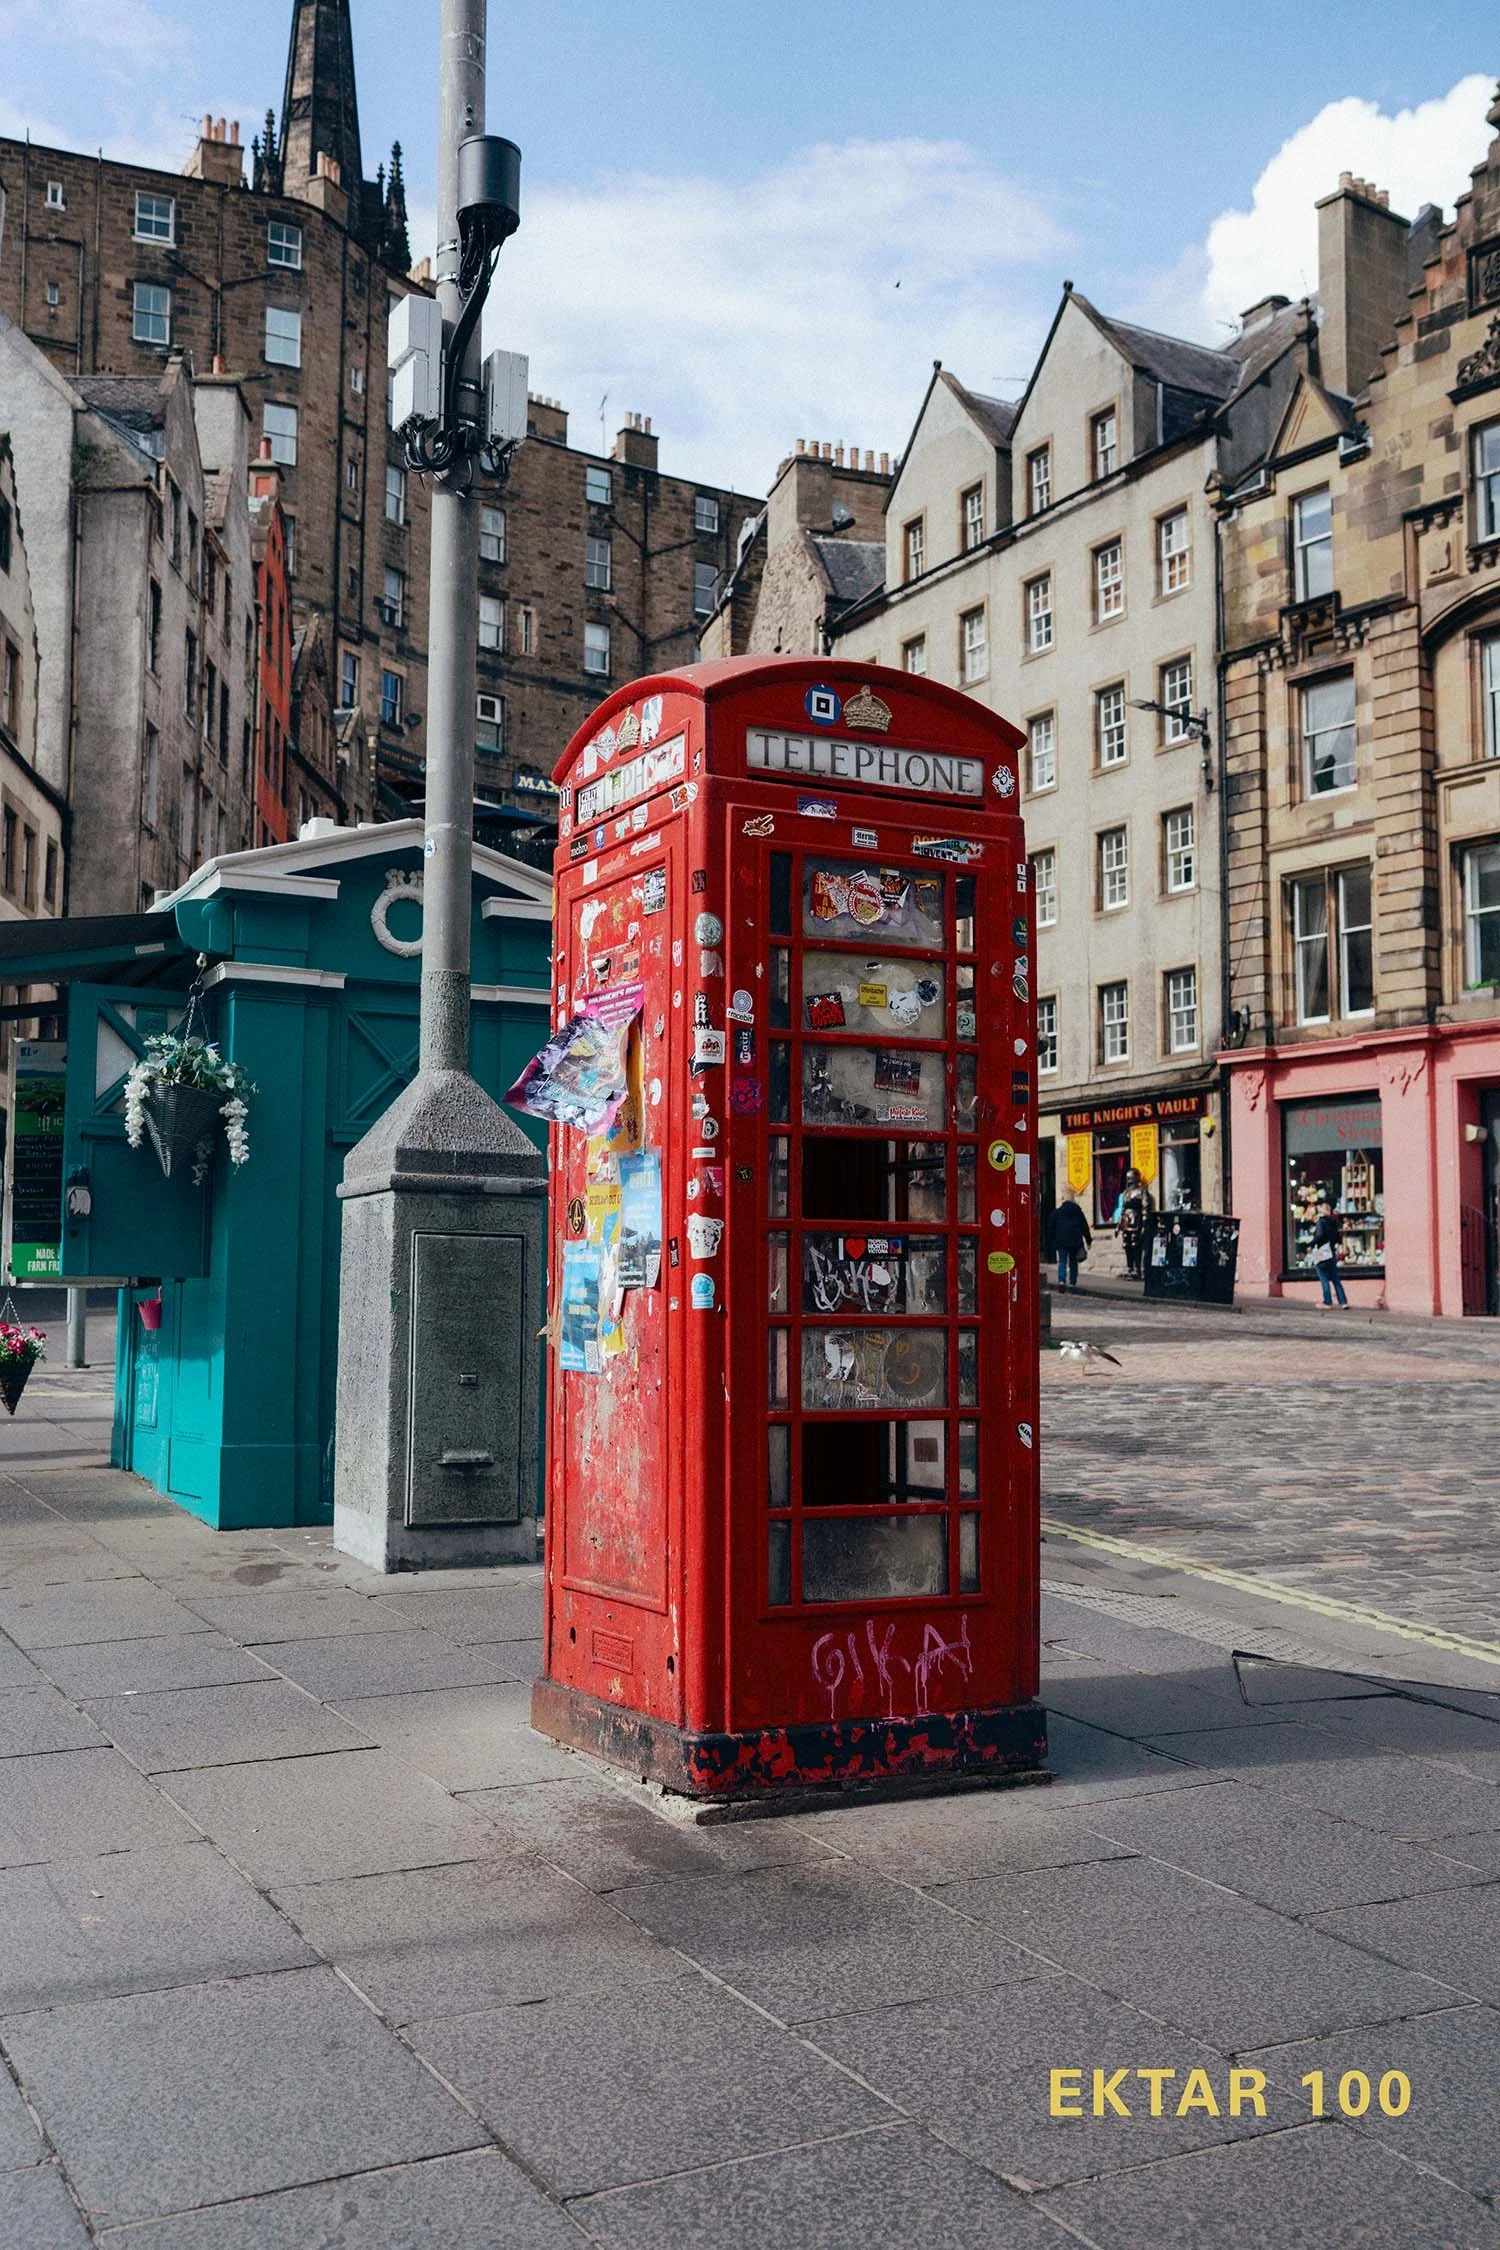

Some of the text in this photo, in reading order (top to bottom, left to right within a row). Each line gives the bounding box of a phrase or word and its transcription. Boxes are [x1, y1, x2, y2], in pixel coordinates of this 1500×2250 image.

[755, 733, 975, 793] TELEPHONE
[728, 1010, 753, 1022] tracebit
[1066, 1098, 1199, 1127] THE KNIGHT'S VAULT
[36, 1249, 55, 1259] MADE
[27, 1260, 48, 1271] FARM
